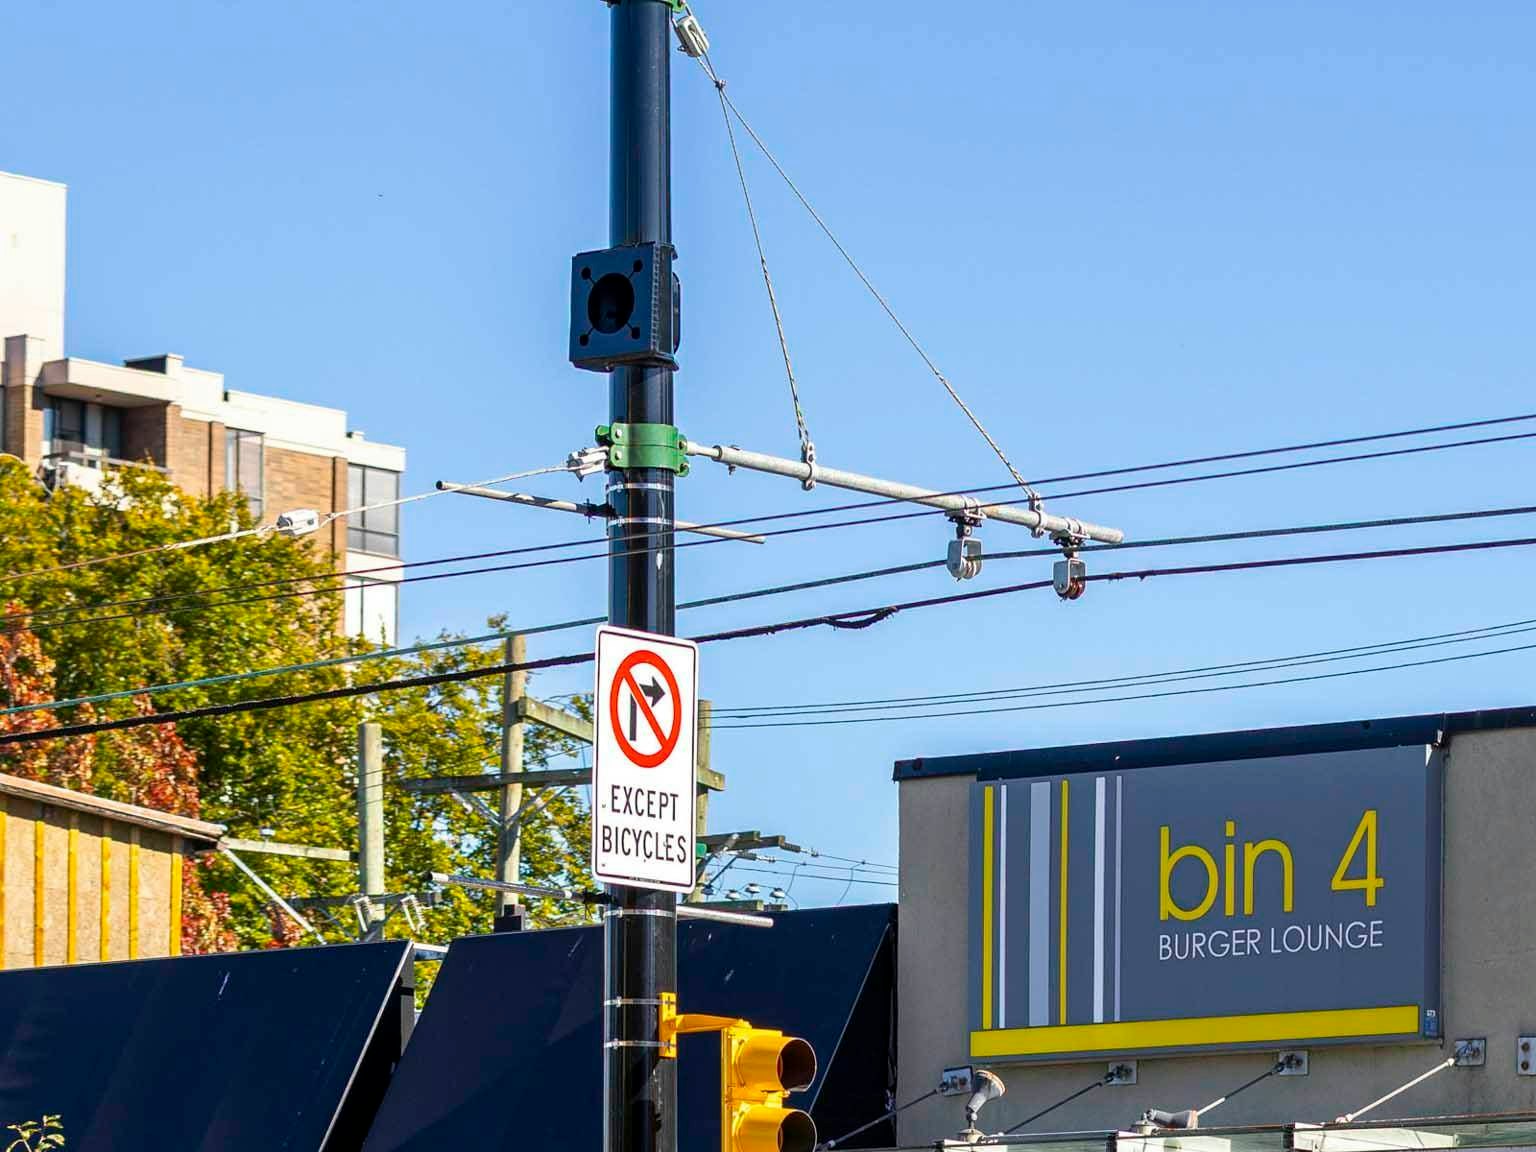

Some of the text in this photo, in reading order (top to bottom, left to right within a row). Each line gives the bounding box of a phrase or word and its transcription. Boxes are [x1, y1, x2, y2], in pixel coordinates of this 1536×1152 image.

[611, 785, 679, 821] EXCEPT
[602, 825, 687, 864] BICYCLES
[1160, 810, 1385, 921] bin 4
[1159, 920, 1384, 961] BURGER LOUNGE
